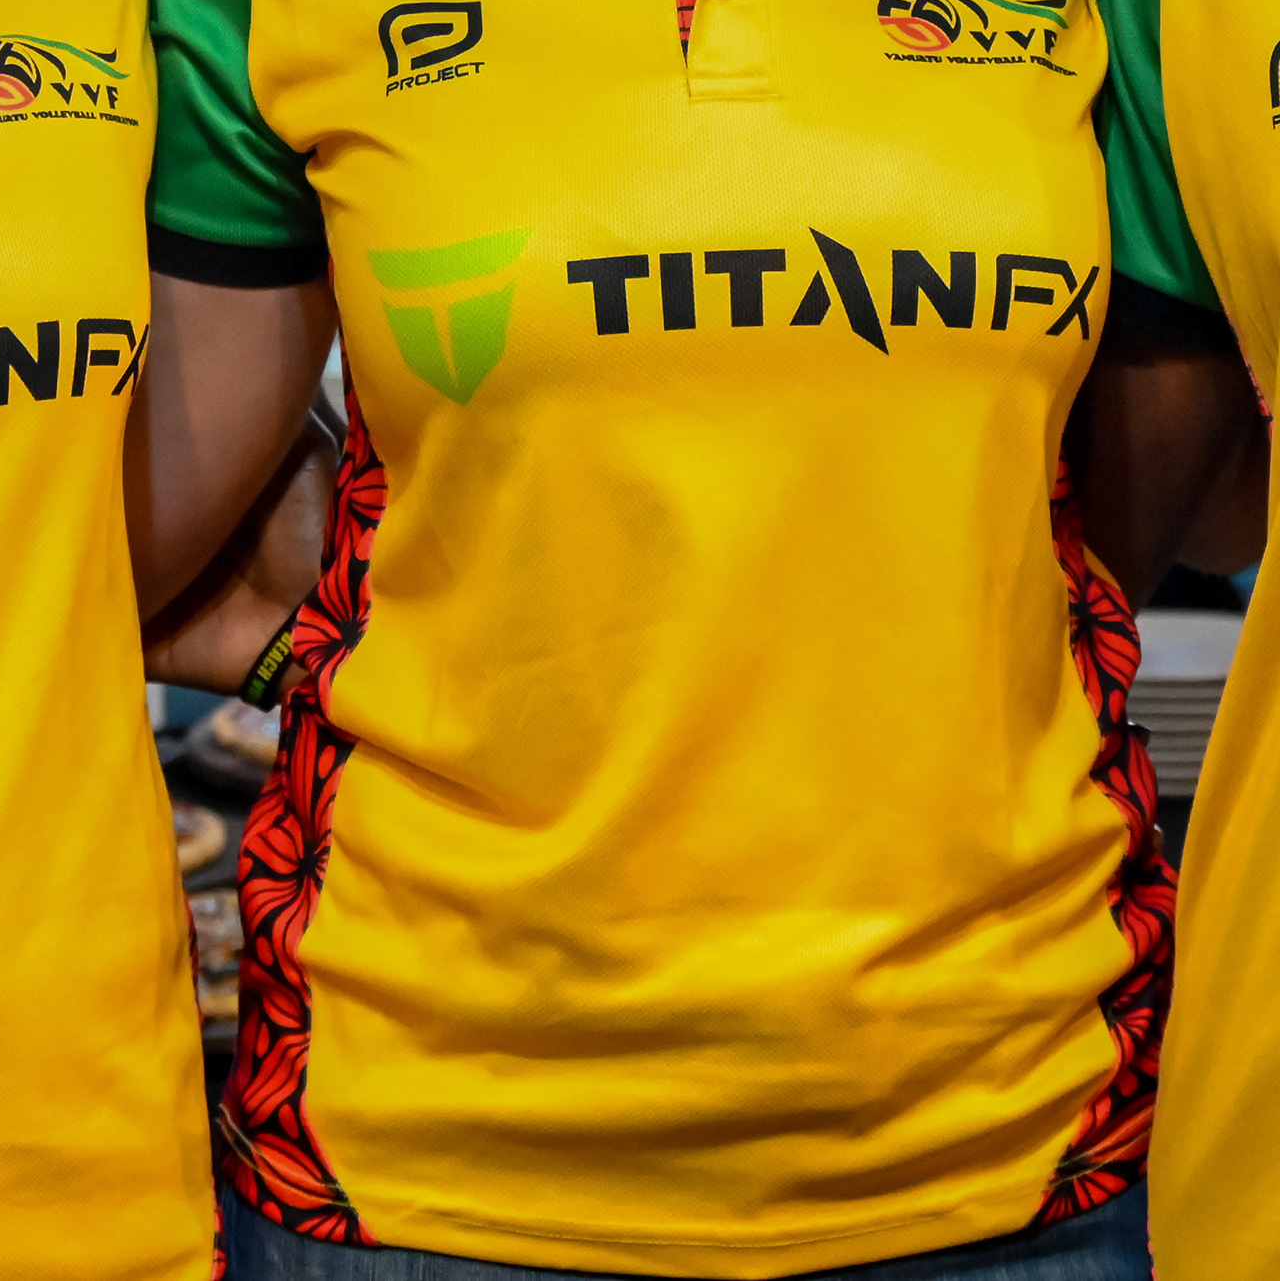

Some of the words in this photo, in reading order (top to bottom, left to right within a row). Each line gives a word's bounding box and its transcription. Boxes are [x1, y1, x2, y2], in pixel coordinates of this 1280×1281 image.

[884, 52, 942, 64] VANUATU
[946, 55, 1026, 65] VOLLEYBALL
[385, 61, 485, 97] PROJECT
[31, 110, 97, 120] VOLLEYBALL
[566, 226, 1100, 356] TITANFX
